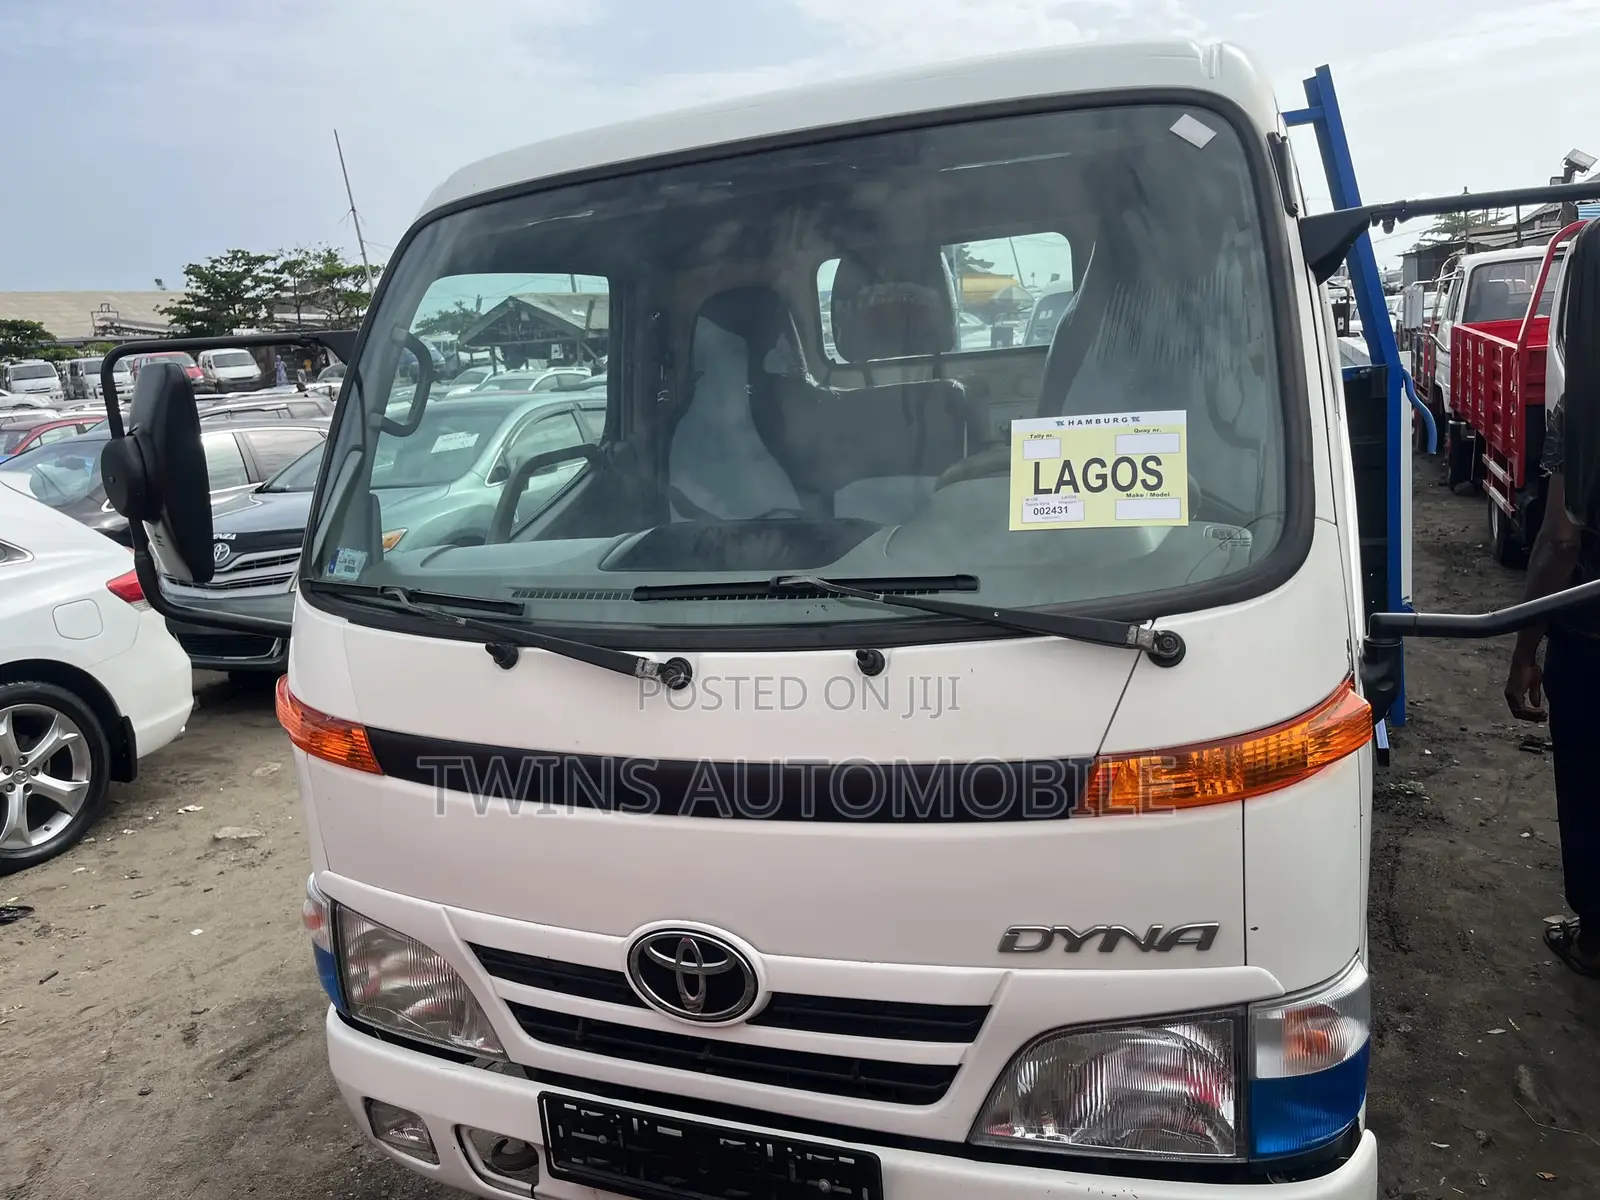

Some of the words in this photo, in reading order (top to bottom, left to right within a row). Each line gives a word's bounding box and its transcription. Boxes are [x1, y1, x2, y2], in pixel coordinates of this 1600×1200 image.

[1068, 416, 1128, 426] HAMBURG
[1033, 455, 1164, 496] LAGOS
[1033, 505, 1068, 516] 002431
[997, 921, 1220, 953] DYNA
